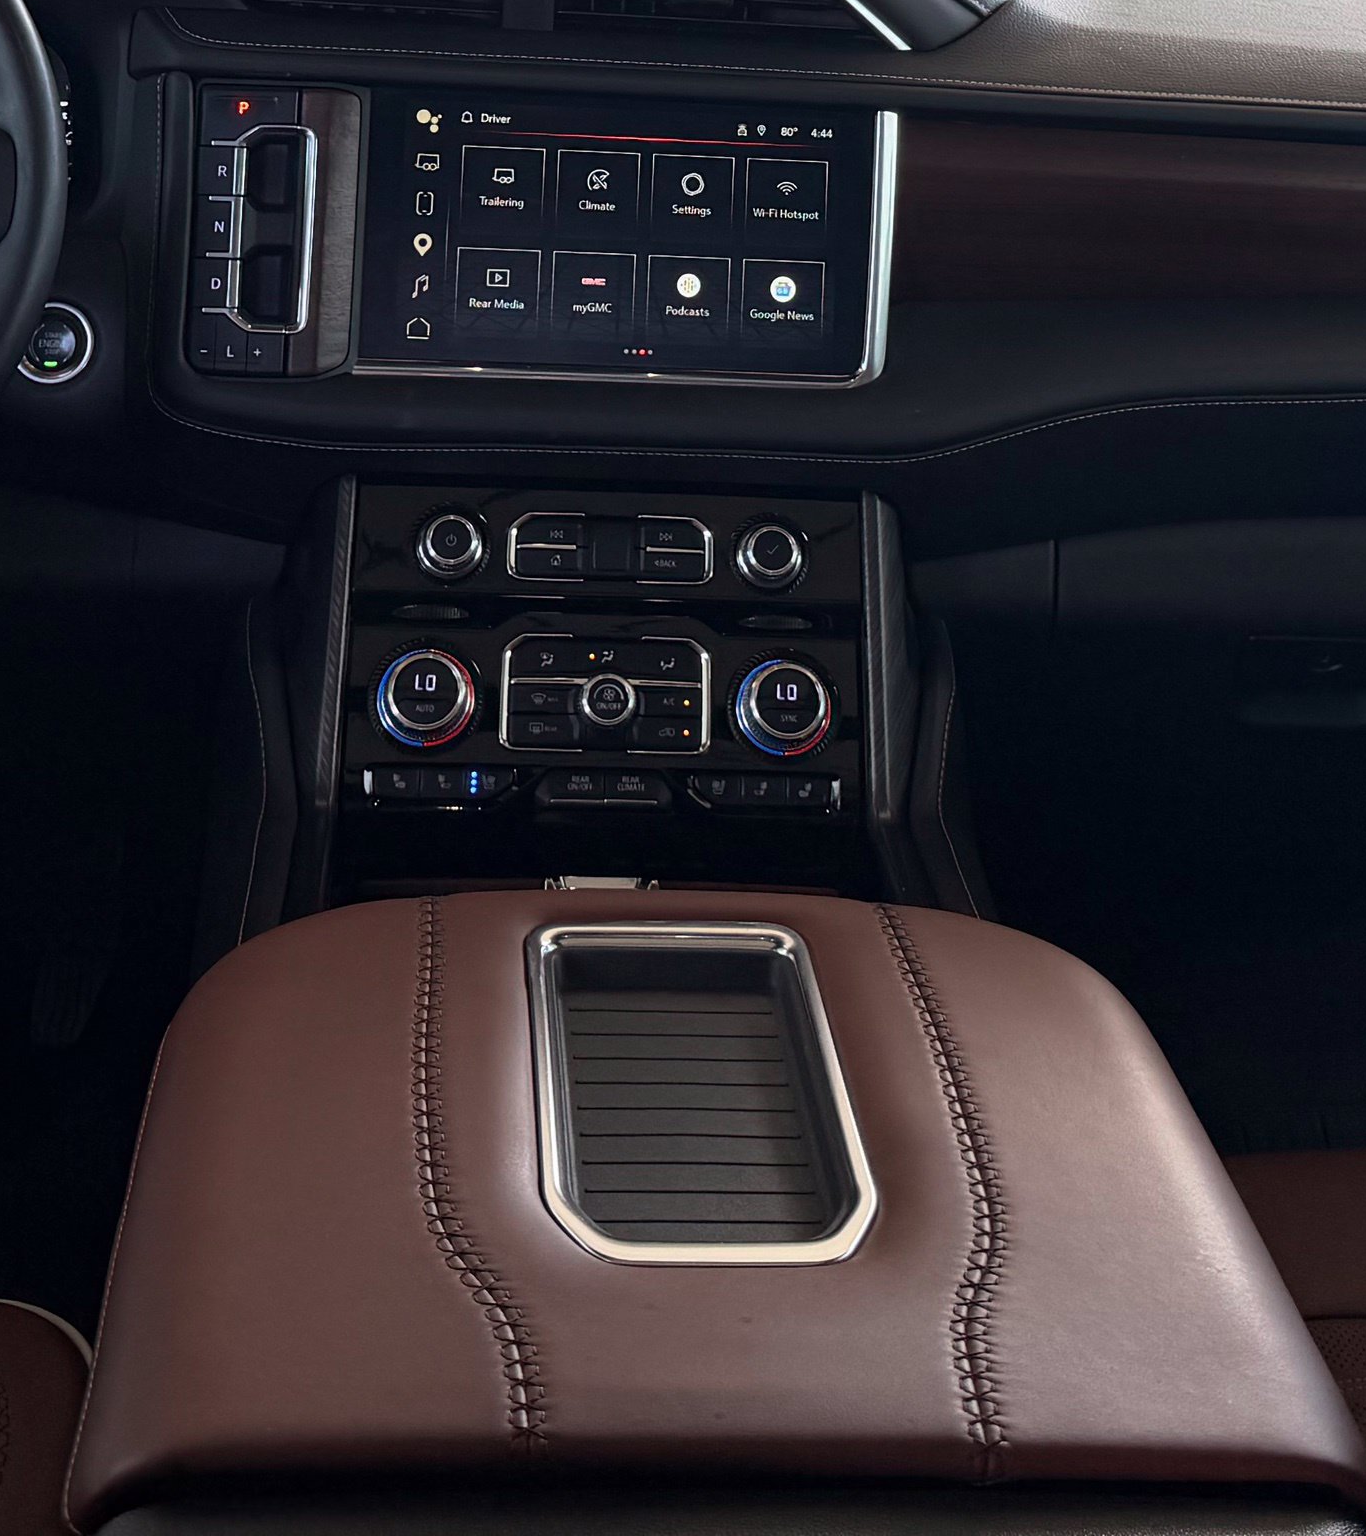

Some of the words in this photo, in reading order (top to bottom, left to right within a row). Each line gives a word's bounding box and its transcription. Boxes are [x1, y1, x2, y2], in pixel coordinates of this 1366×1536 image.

[238, 101, 249, 114] P
[480, 113, 511, 124] Driver
[780, 126, 799, 137] 80°
[811, 128, 834, 138] 4:44
[217, 165, 228, 177] R
[479, 196, 524, 210] Trailering
[578, 200, 616, 212] Climate
[672, 204, 712, 218] Settings
[752, 207, 779, 219] Wi-Fi
[780, 209, 819, 222] Hotspot
[214, 221, 225, 234] N
[211, 277, 222, 290] D
[469, 298, 492, 309] Rear
[494, 299, 524, 311] Media
[572, 302, 613, 315] myGMC
[665, 305, 711, 317] Podcasts
[749, 308, 785, 322] Google
[787, 311, 815, 322] News
[226, 345, 235, 357] L
[415, 673, 437, 692] LO
[776, 683, 798, 701] LO
[415, 704, 436, 713] AUTO
[595, 703, 621, 712] ON/OFF
[780, 714, 799, 723] SYNC
[571, 775, 590, 784] REAR
[621, 775, 640, 784] REAR
